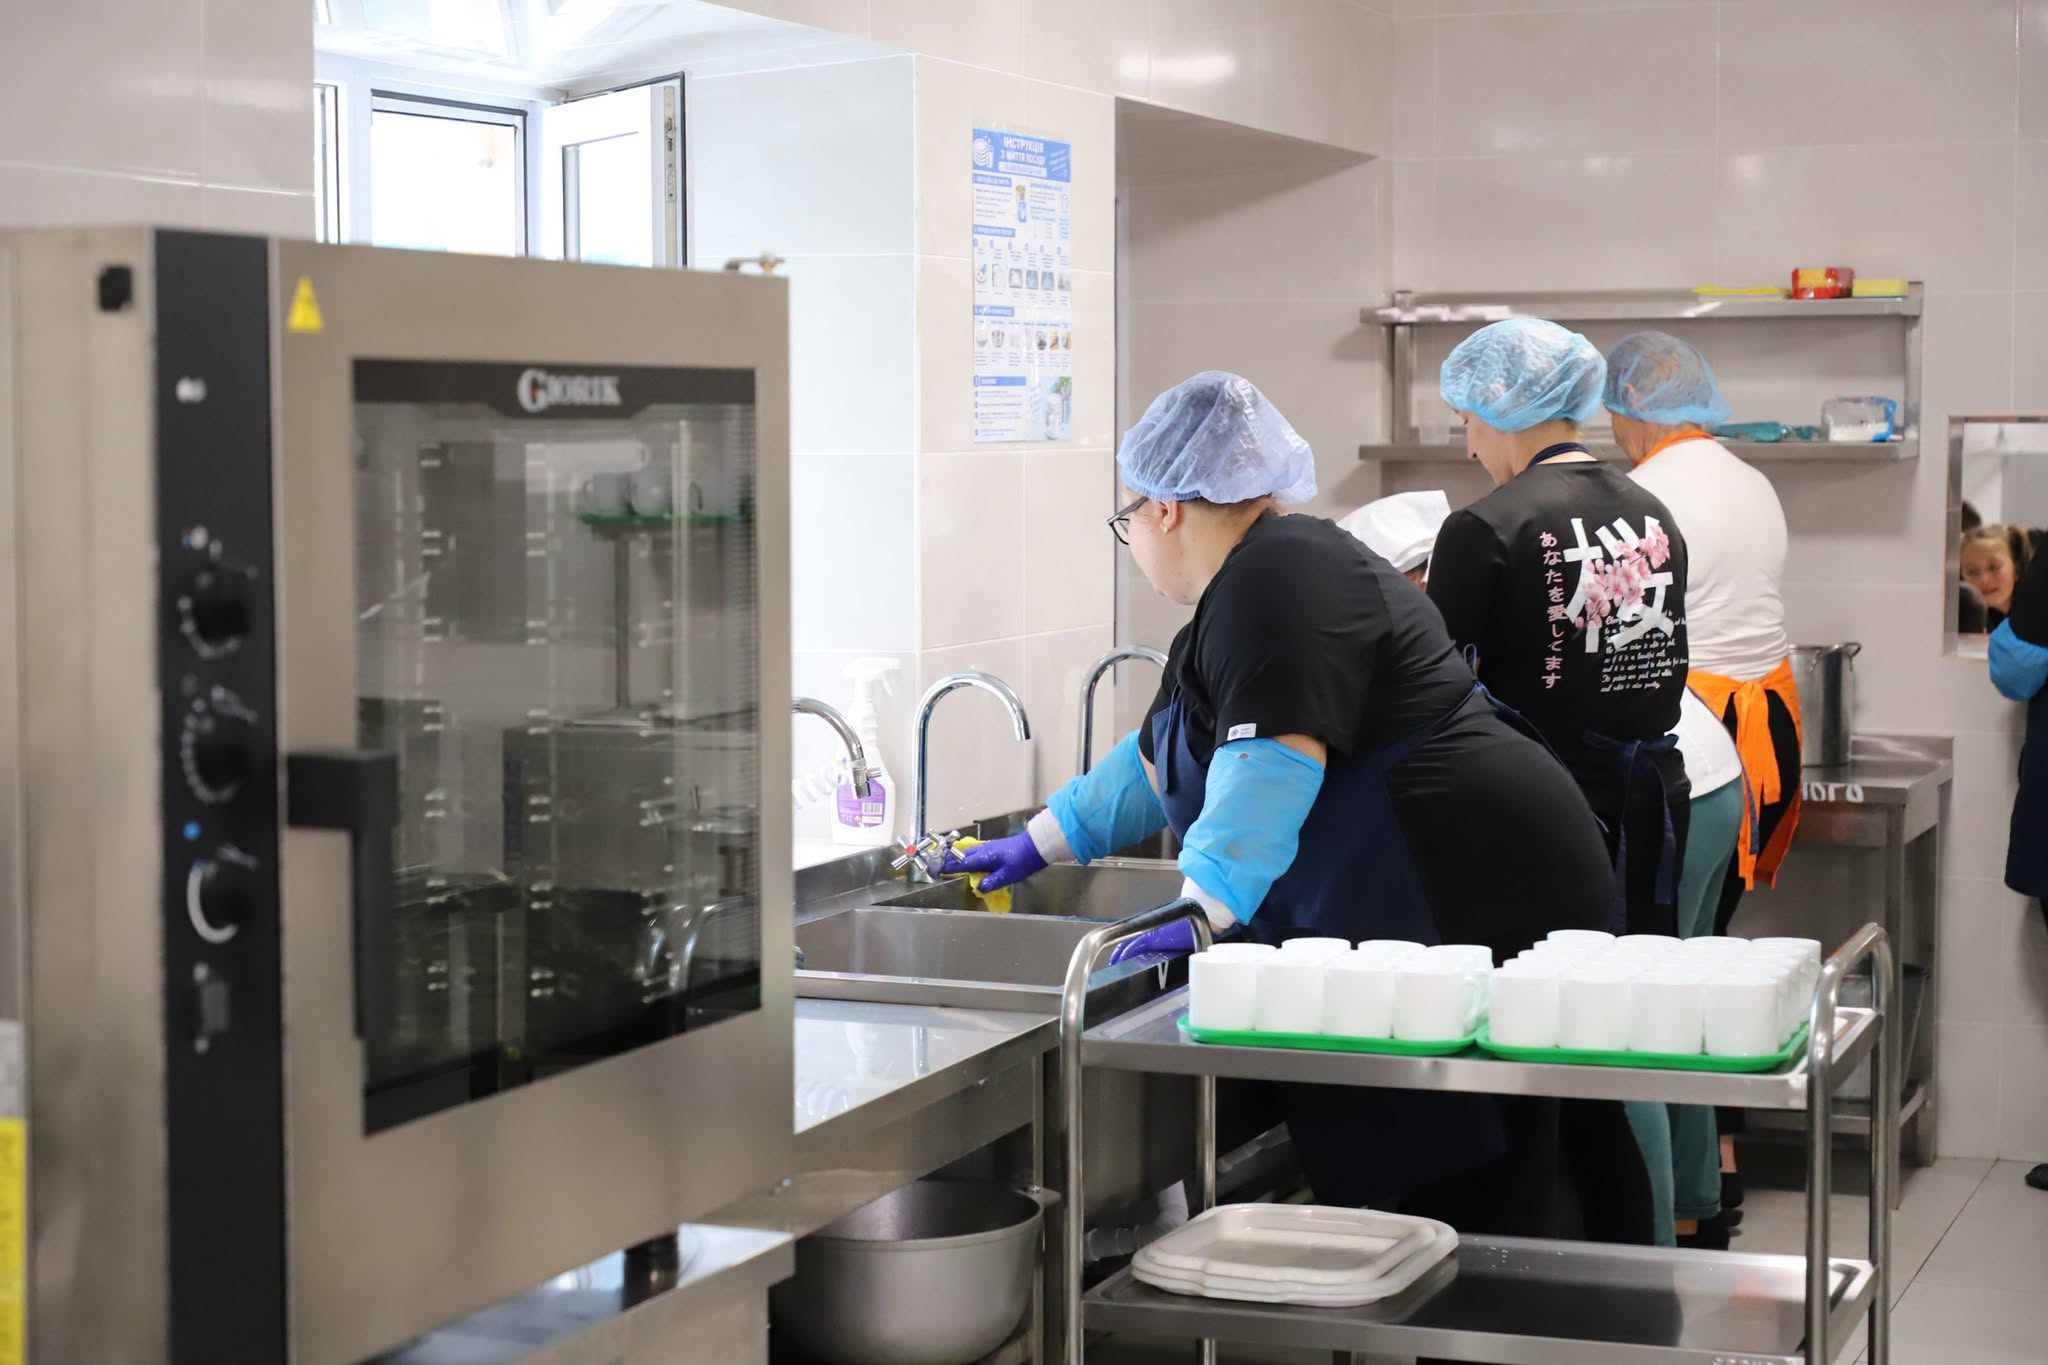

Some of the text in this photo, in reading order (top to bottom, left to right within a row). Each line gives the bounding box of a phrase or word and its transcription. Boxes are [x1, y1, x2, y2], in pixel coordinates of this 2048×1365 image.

[1539, 531, 1568, 689] あなたを愛してます
